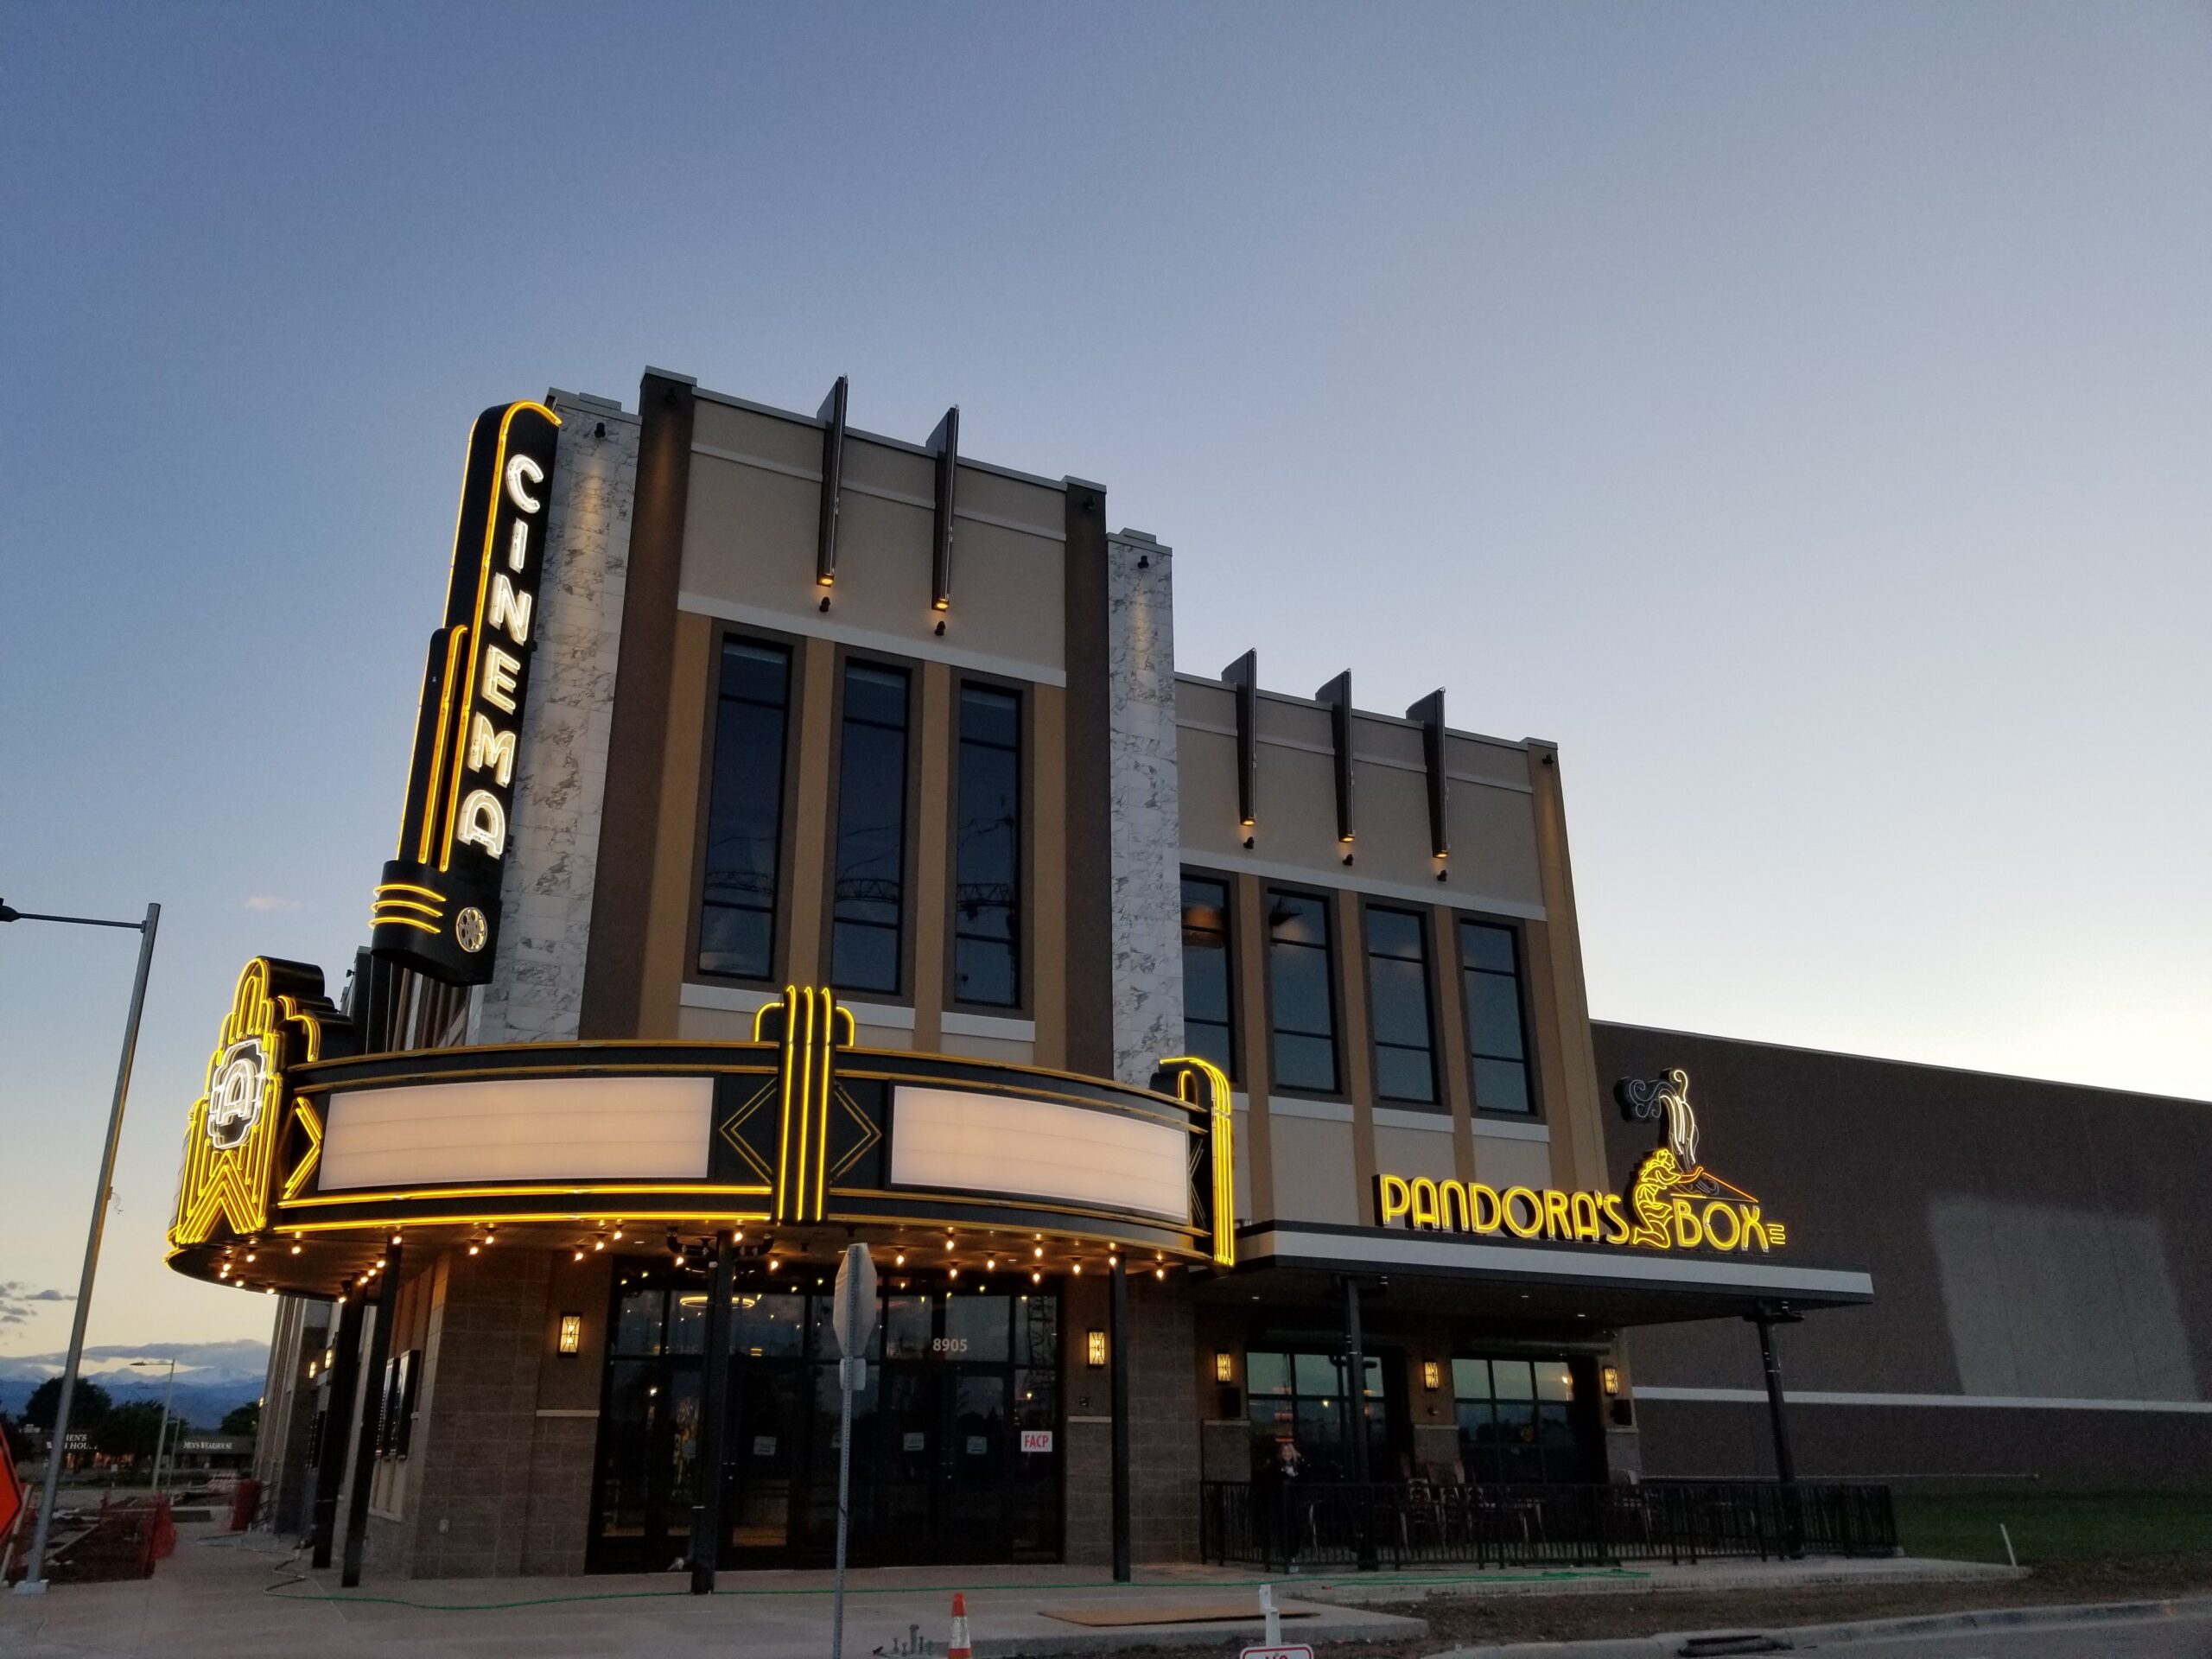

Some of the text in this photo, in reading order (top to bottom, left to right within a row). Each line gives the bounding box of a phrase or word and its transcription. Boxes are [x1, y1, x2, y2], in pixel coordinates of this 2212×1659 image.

[458, 454, 544, 860] CINEMA
[1378, 1174, 1770, 1252] PANDORA'S BOX
[932, 1338, 968, 1352] 8905
[1024, 1434, 1049, 1448] FACP
